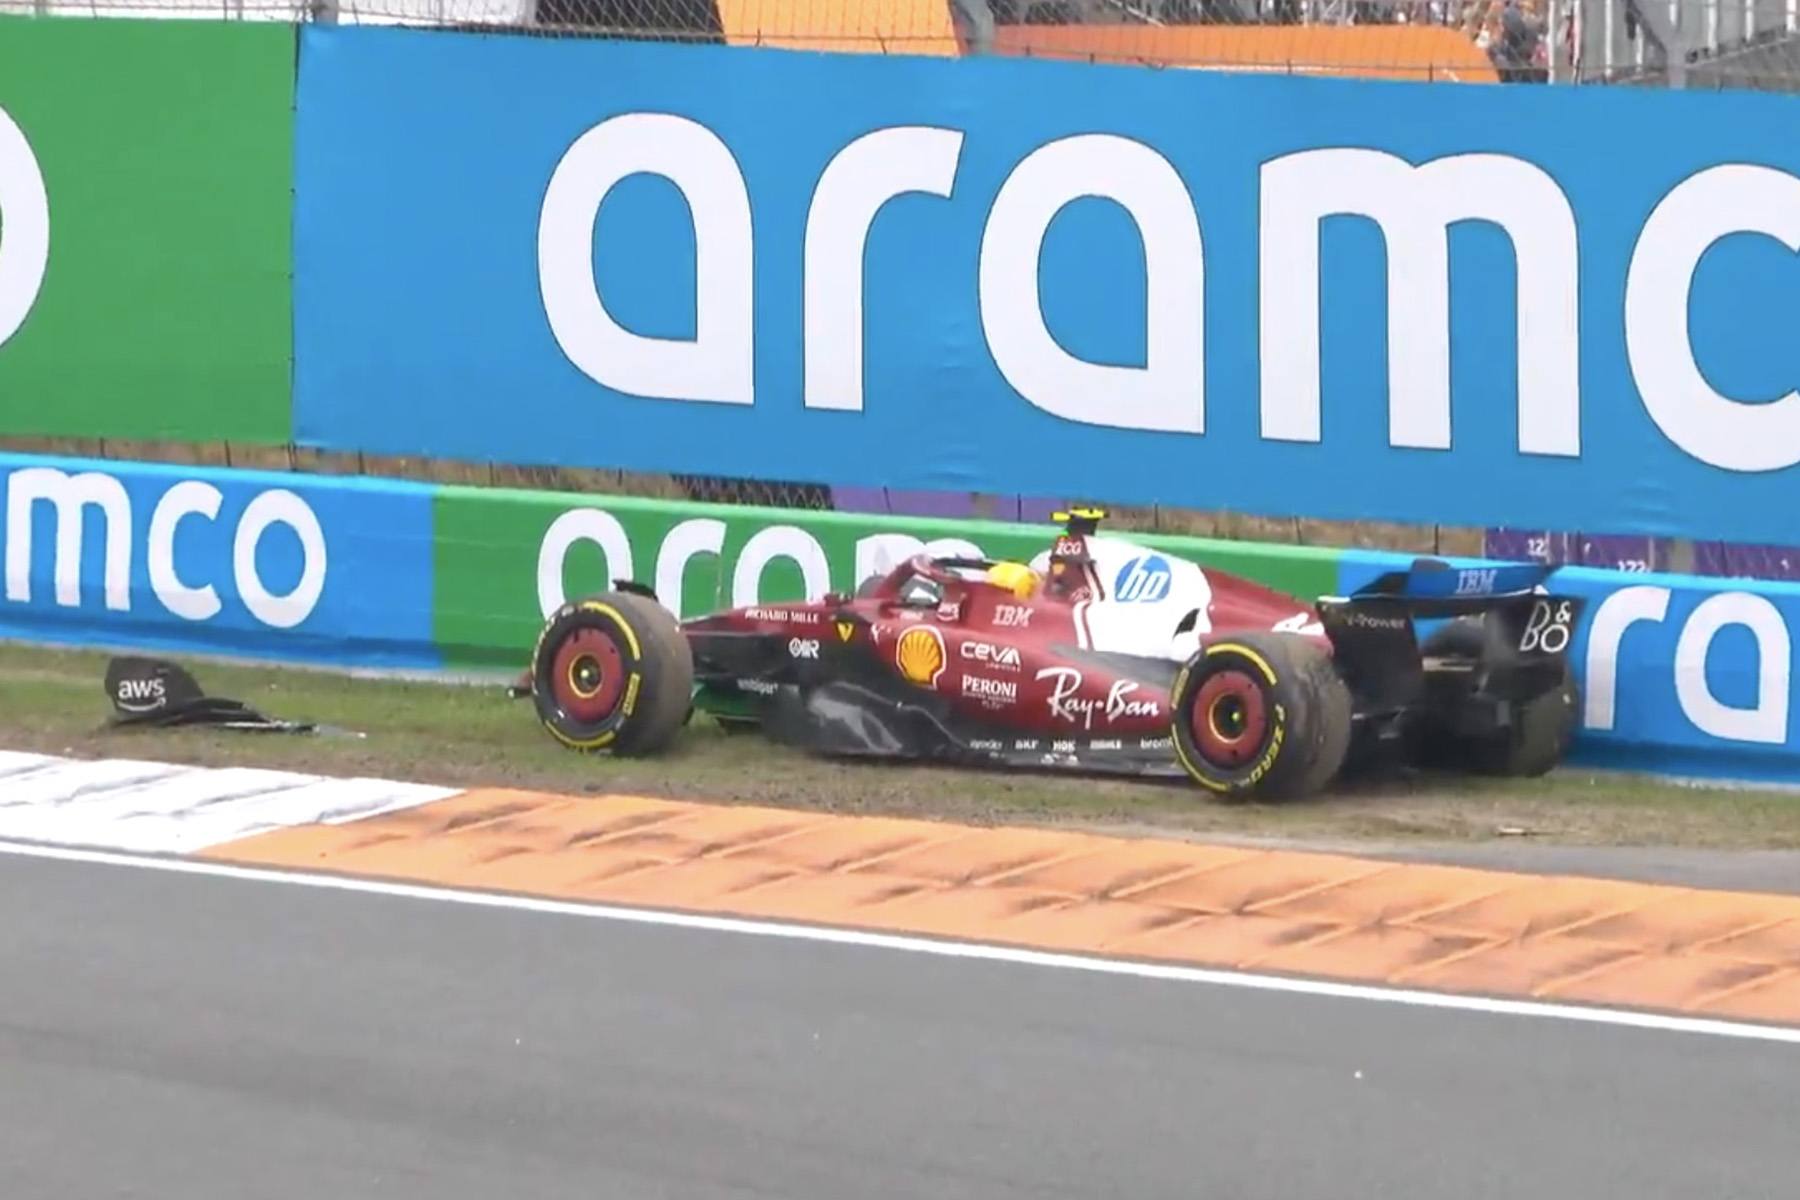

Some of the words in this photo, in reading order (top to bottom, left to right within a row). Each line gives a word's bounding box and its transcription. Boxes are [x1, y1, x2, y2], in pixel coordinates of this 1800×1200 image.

[6, 467, 327, 628] mco
[1117, 555, 1168, 603] hp
[1454, 569, 1498, 595] IBM
[790, 611, 820, 624] MILLE
[991, 604, 1034, 628] IBM
[118, 678, 166, 700] aws
[962, 674, 1017, 698] PERONI
